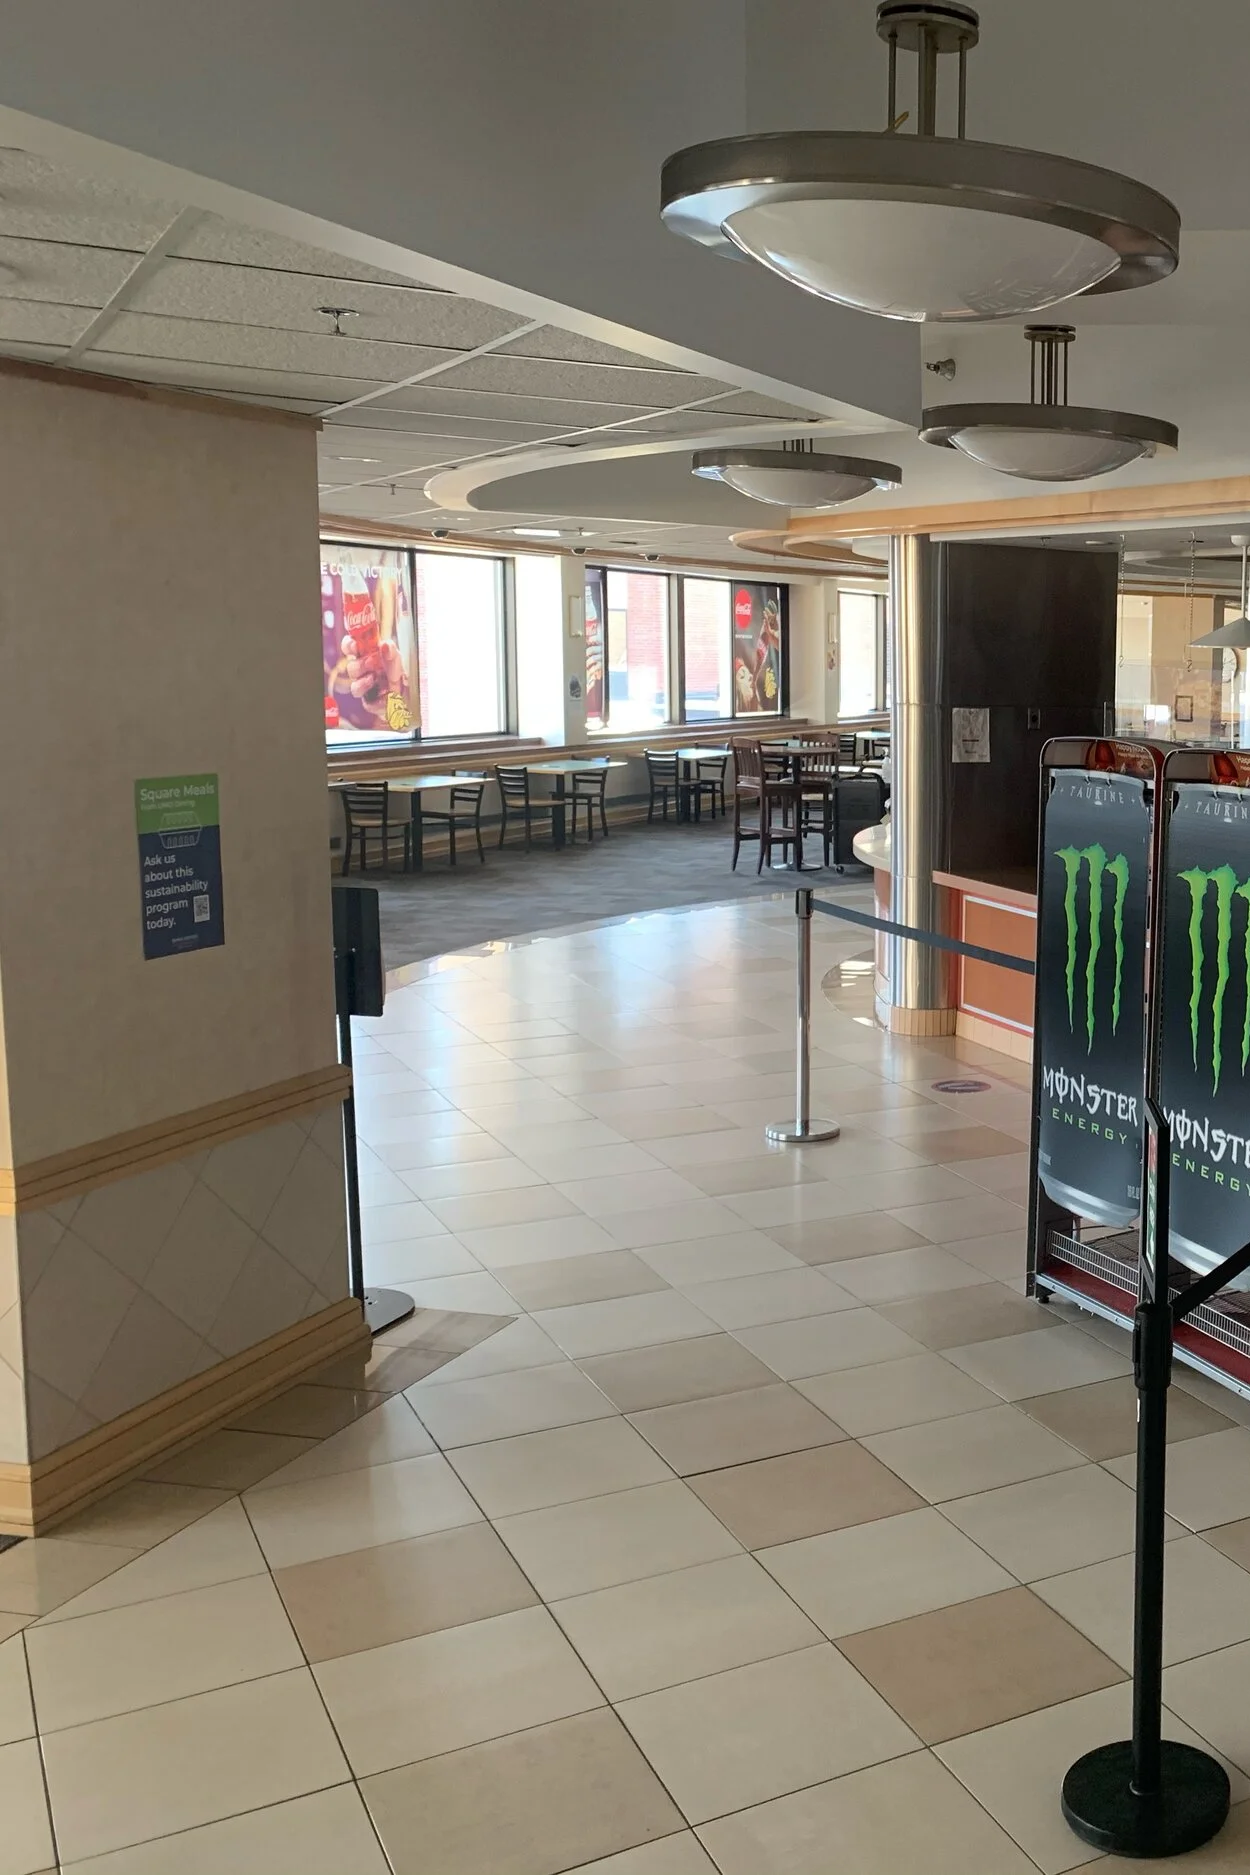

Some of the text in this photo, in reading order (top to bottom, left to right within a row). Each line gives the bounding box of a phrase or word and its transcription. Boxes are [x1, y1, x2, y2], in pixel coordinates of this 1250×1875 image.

[140, 782, 215, 802] Square Meals
[1070, 785, 1124, 804] TAURINE
[144, 854, 176, 867] Ask us
[144, 866, 194, 883] about this
[145, 881, 209, 898] sustainability
[146, 899, 189, 916] program
[146, 916, 177, 930] today.
[1052, 1107, 1128, 1145] ENERGY
